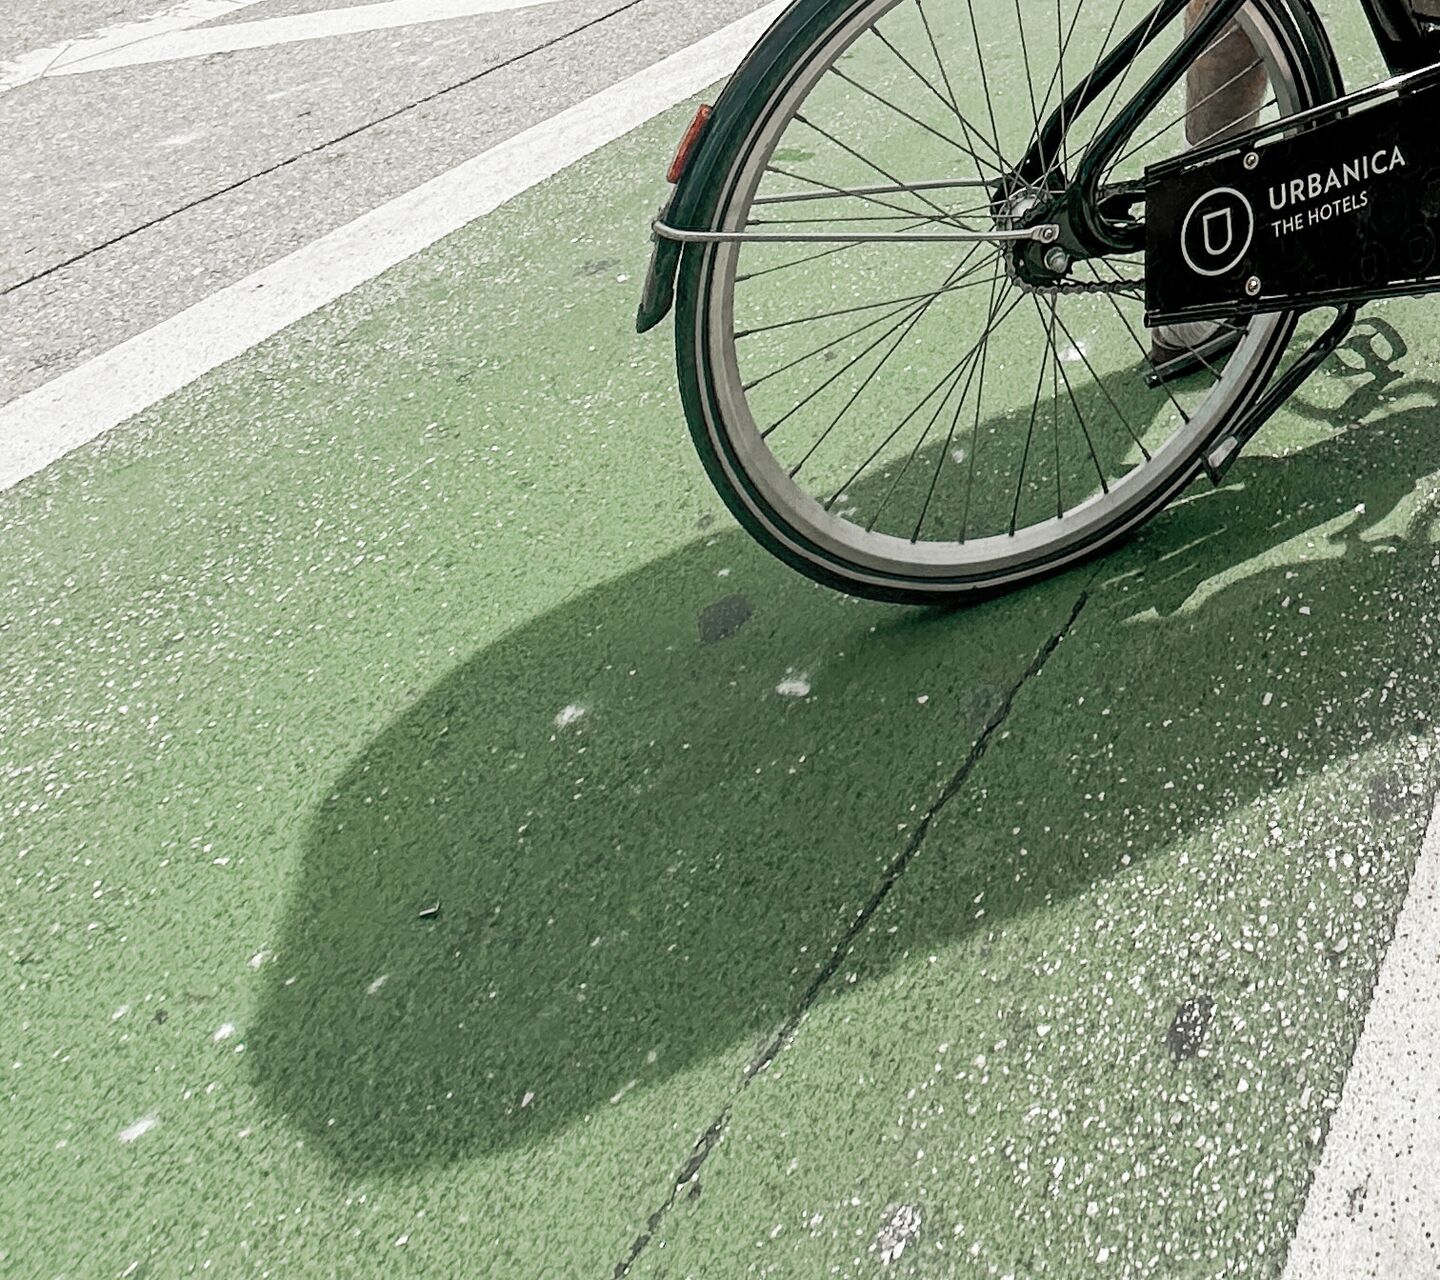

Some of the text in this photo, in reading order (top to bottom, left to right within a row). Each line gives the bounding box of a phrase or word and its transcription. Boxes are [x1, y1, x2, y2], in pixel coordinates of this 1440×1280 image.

[1268, 145, 1406, 210] URBANICA
[1270, 190, 1369, 238] THE HOTELS
